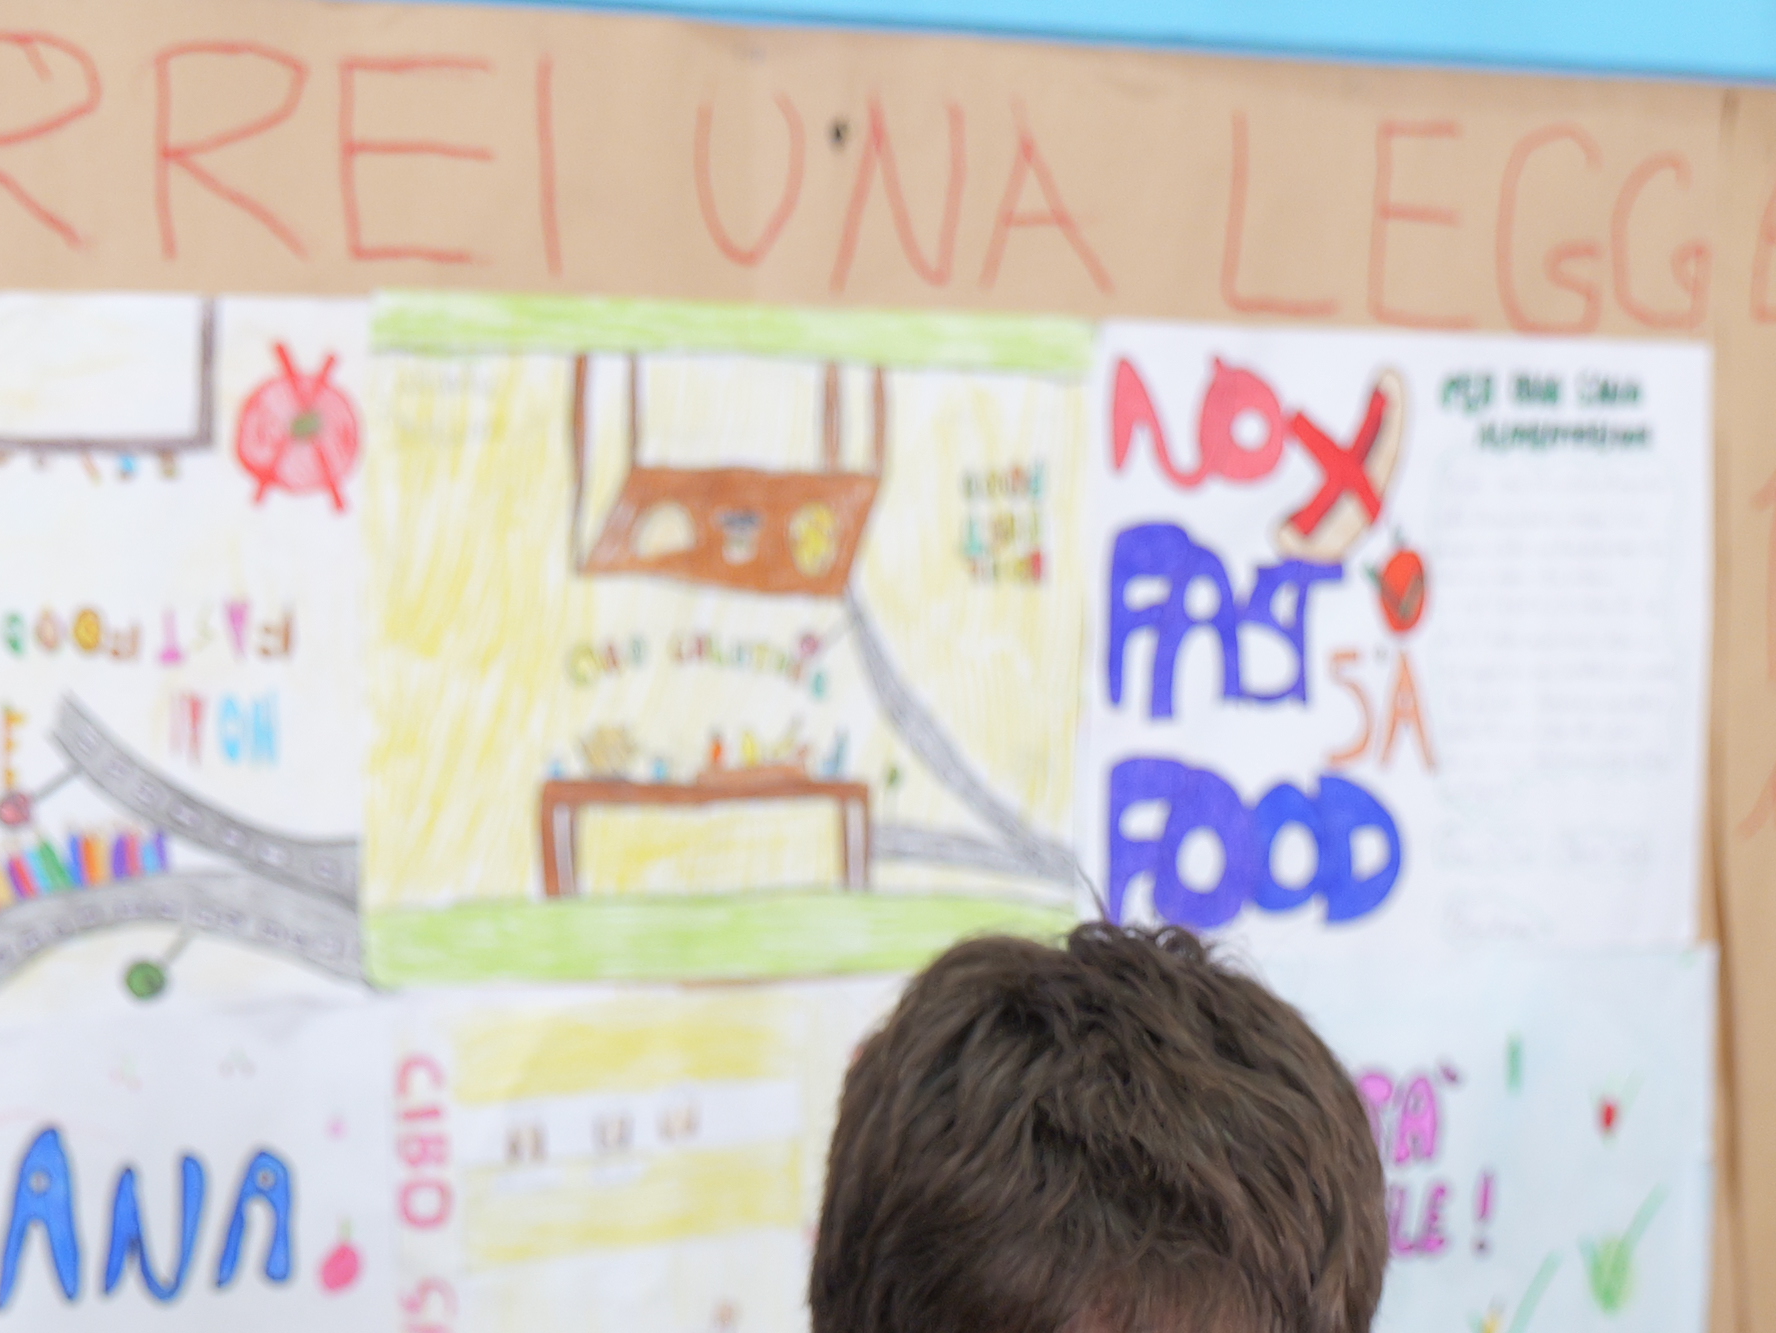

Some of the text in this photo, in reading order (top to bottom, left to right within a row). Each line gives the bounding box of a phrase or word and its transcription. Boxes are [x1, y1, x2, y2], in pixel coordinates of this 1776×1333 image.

[694, 89, 1116, 296] UNA
[1106, 755, 1401, 931] FOOD
[393, 1050, 455, 1232] CIBO
